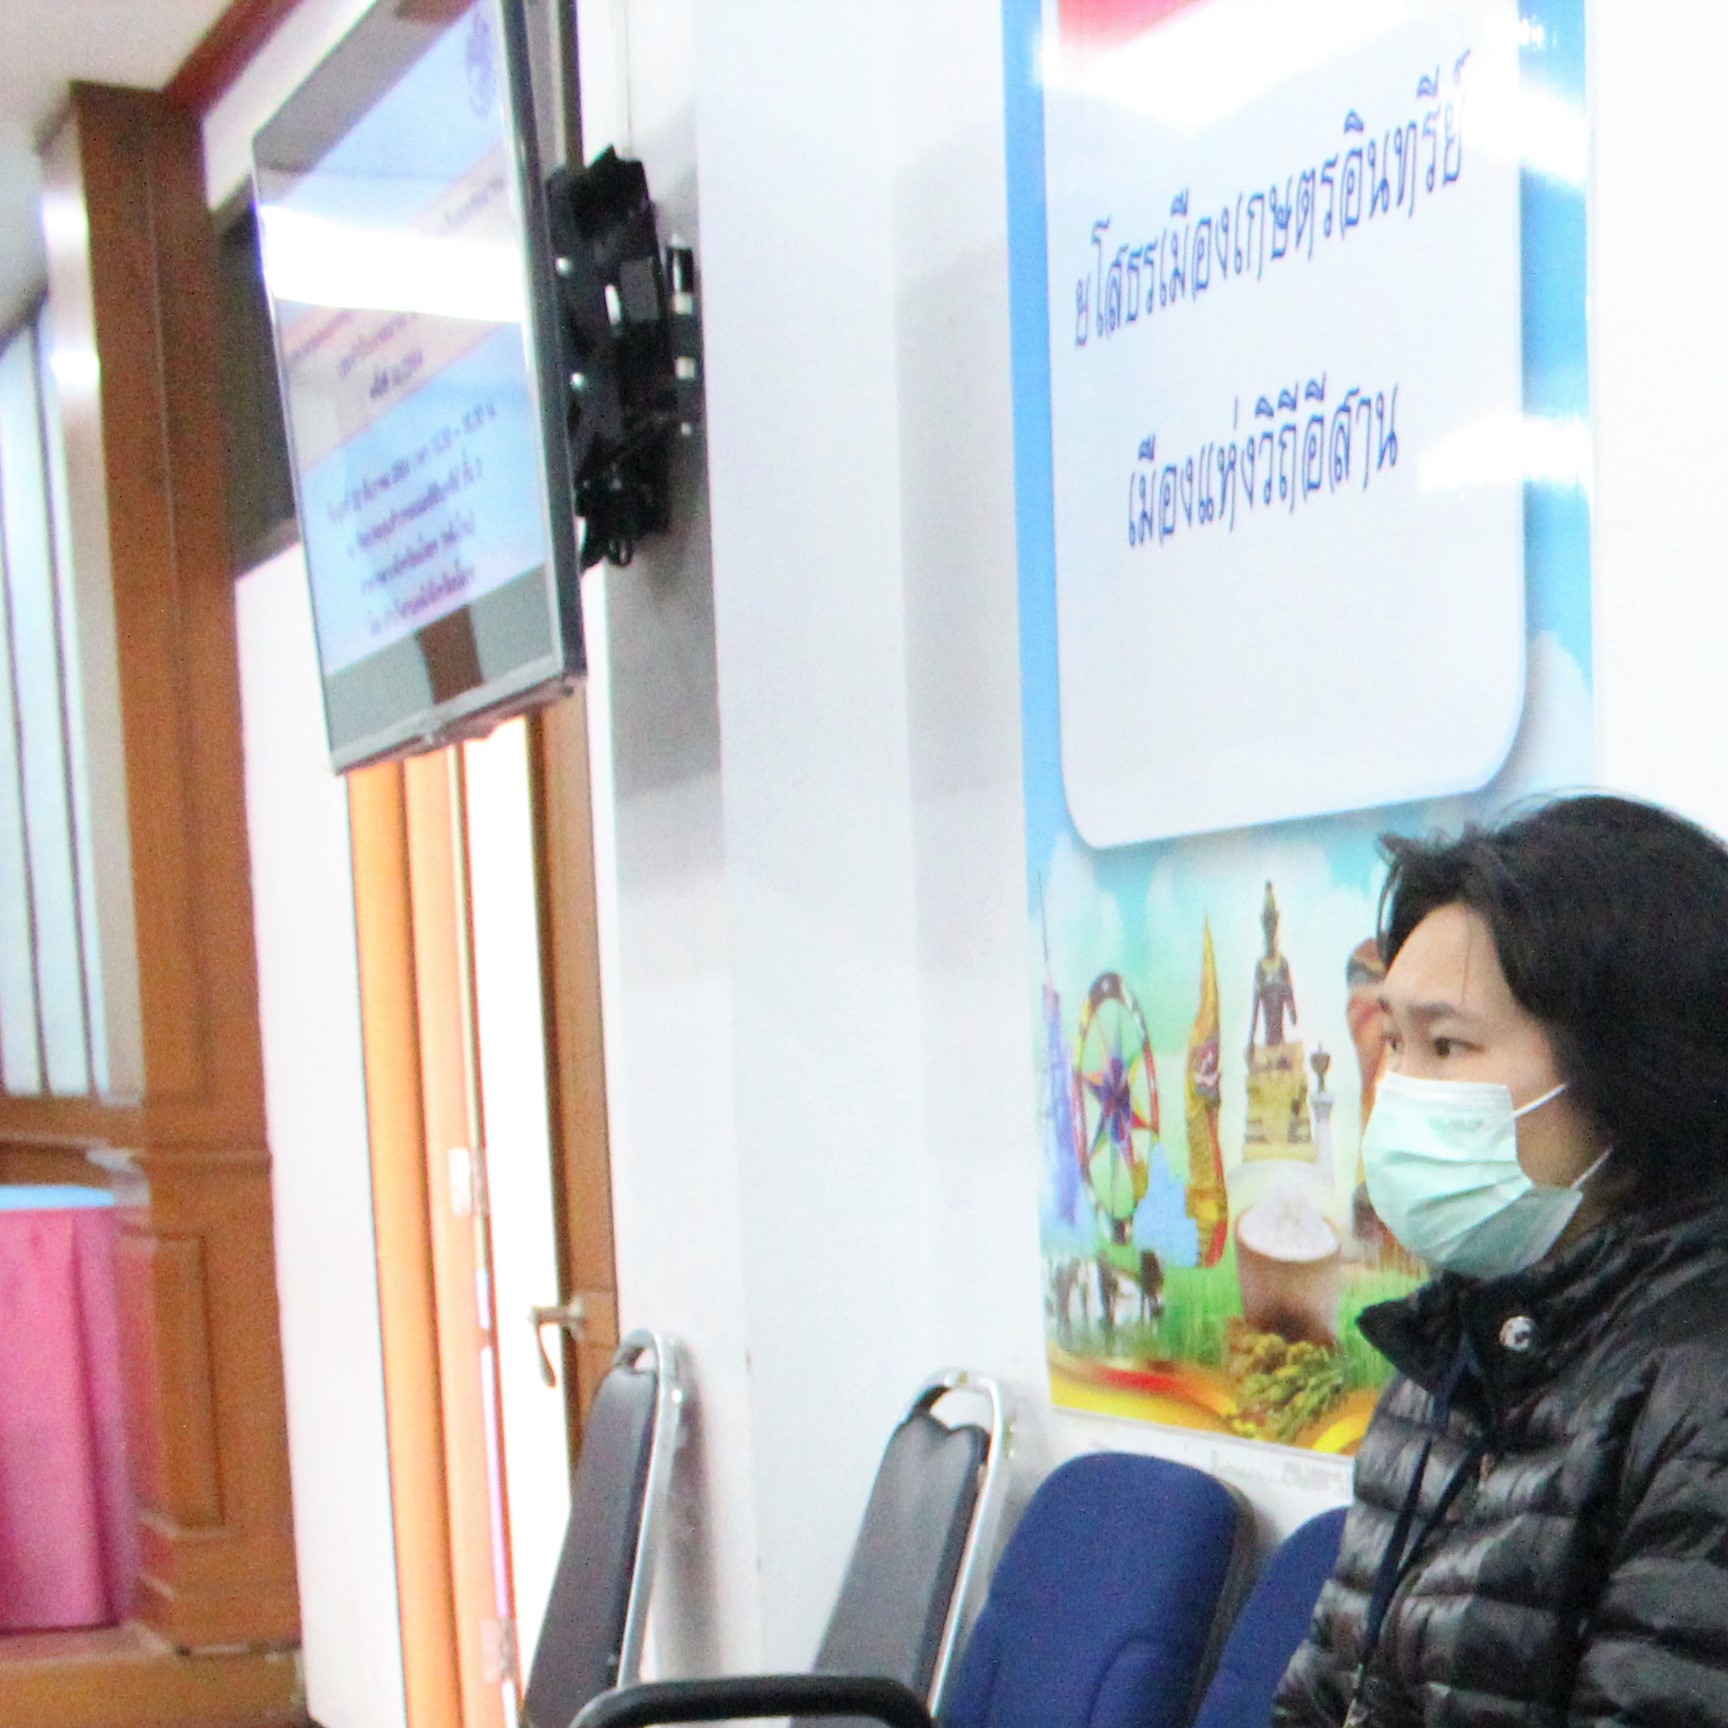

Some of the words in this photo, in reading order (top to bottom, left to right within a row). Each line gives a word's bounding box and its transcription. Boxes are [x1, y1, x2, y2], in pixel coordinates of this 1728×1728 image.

[1128, 372, 1399, 549] เมืองแห่งวิถีอีสาน
